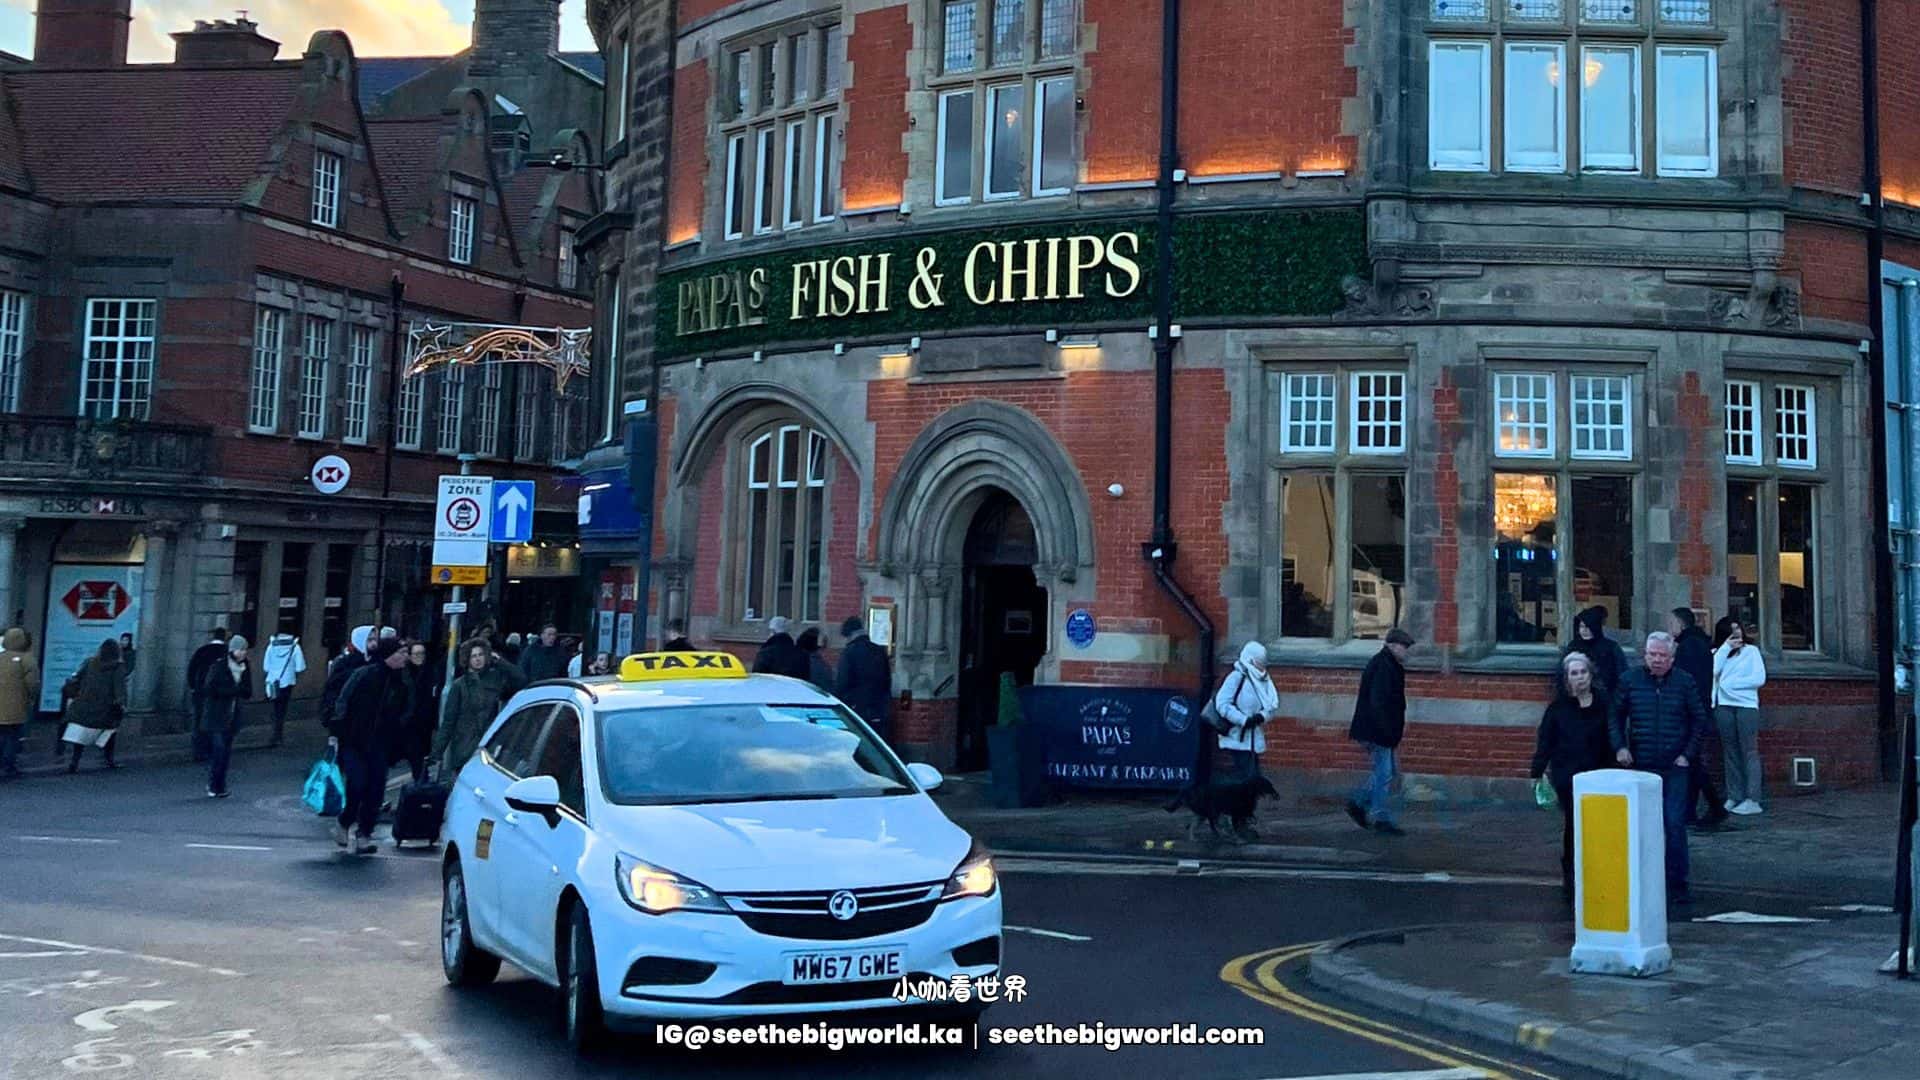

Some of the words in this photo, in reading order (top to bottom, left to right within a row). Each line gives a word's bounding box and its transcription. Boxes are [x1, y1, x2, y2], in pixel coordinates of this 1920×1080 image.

[789, 252, 891, 320] FISH
[908, 247, 945, 309] &
[964, 231, 1141, 305] CHIPS
[447, 485, 483, 495] ZONE
[40, 498, 92, 514] HSBC
[633, 655, 732, 670] TAXI
[1124, 765, 1191, 781] TAKEAWAY
[793, 956, 852, 981] MW67
[859, 952, 900, 977] GWE
